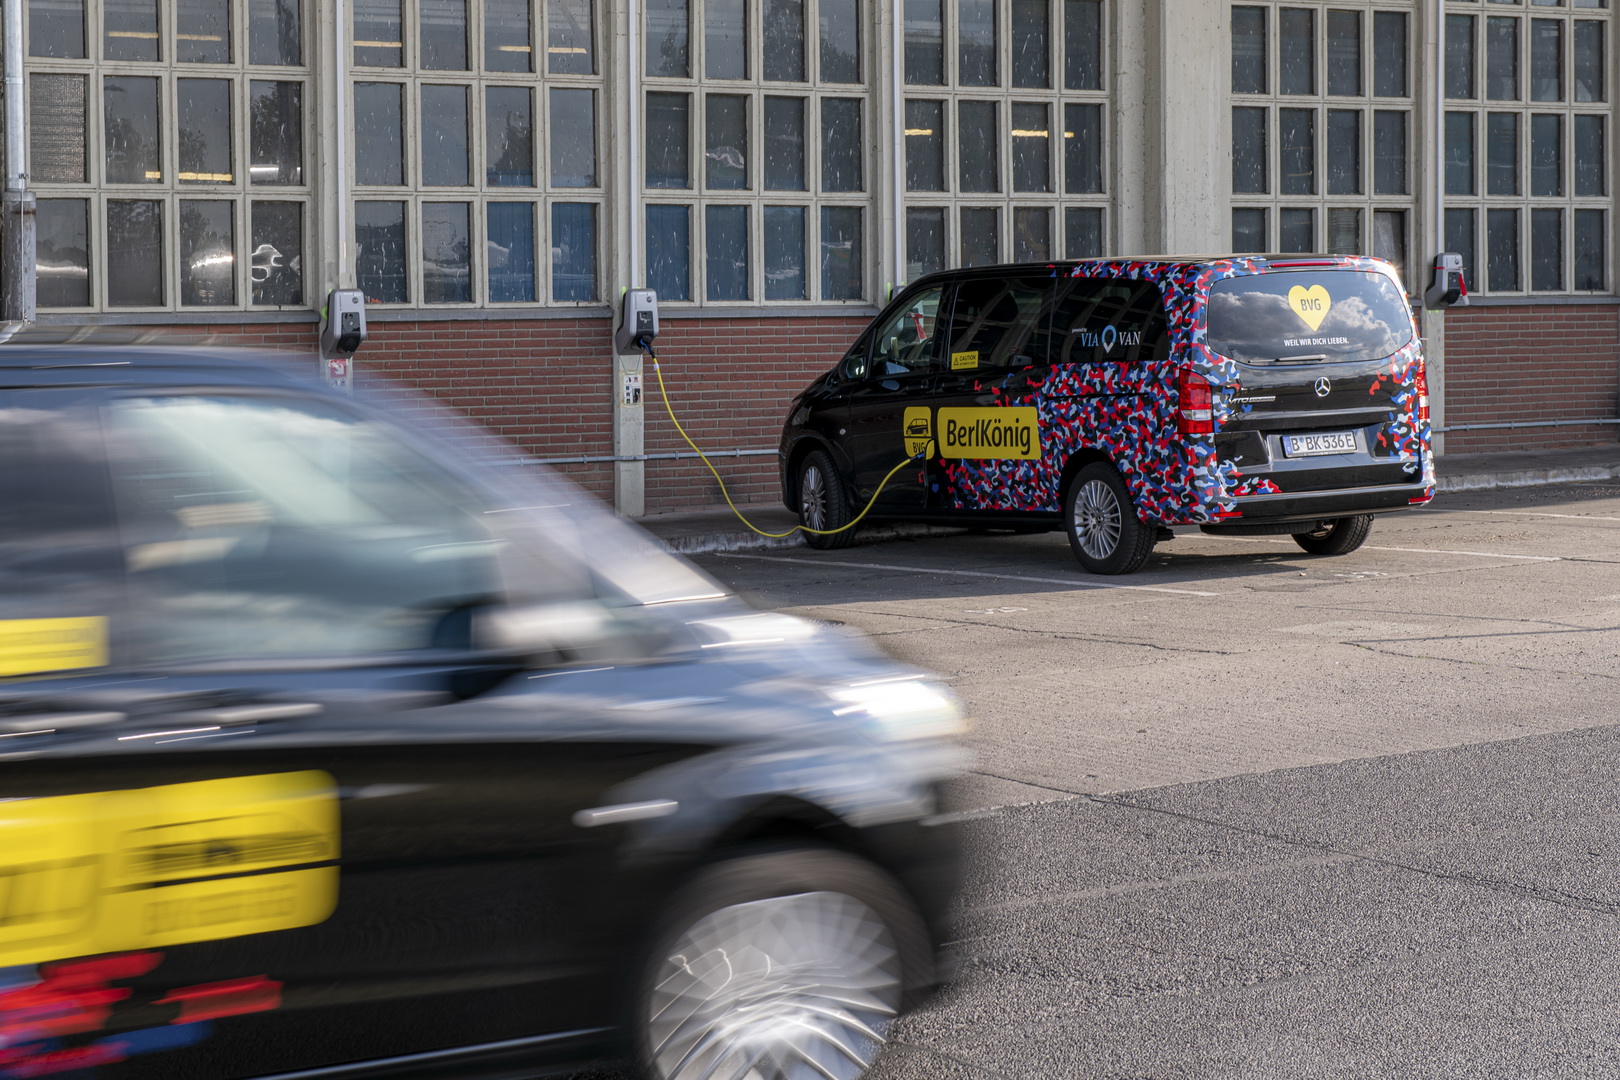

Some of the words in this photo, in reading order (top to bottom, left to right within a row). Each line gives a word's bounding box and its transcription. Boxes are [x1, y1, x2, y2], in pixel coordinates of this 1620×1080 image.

[1300, 298, 1321, 311] BVG
[1081, 332, 1099, 347] VIA
[1119, 331, 1141, 346] VAN
[1284, 339, 1299, 347] WEIL
[1300, 338, 1312, 346] WIR
[1327, 336, 1350, 345] LIEBEN.
[946, 418, 1031, 456] BerlKönig
[912, 442, 926, 454] BVG
[1291, 437, 1300, 451] B
